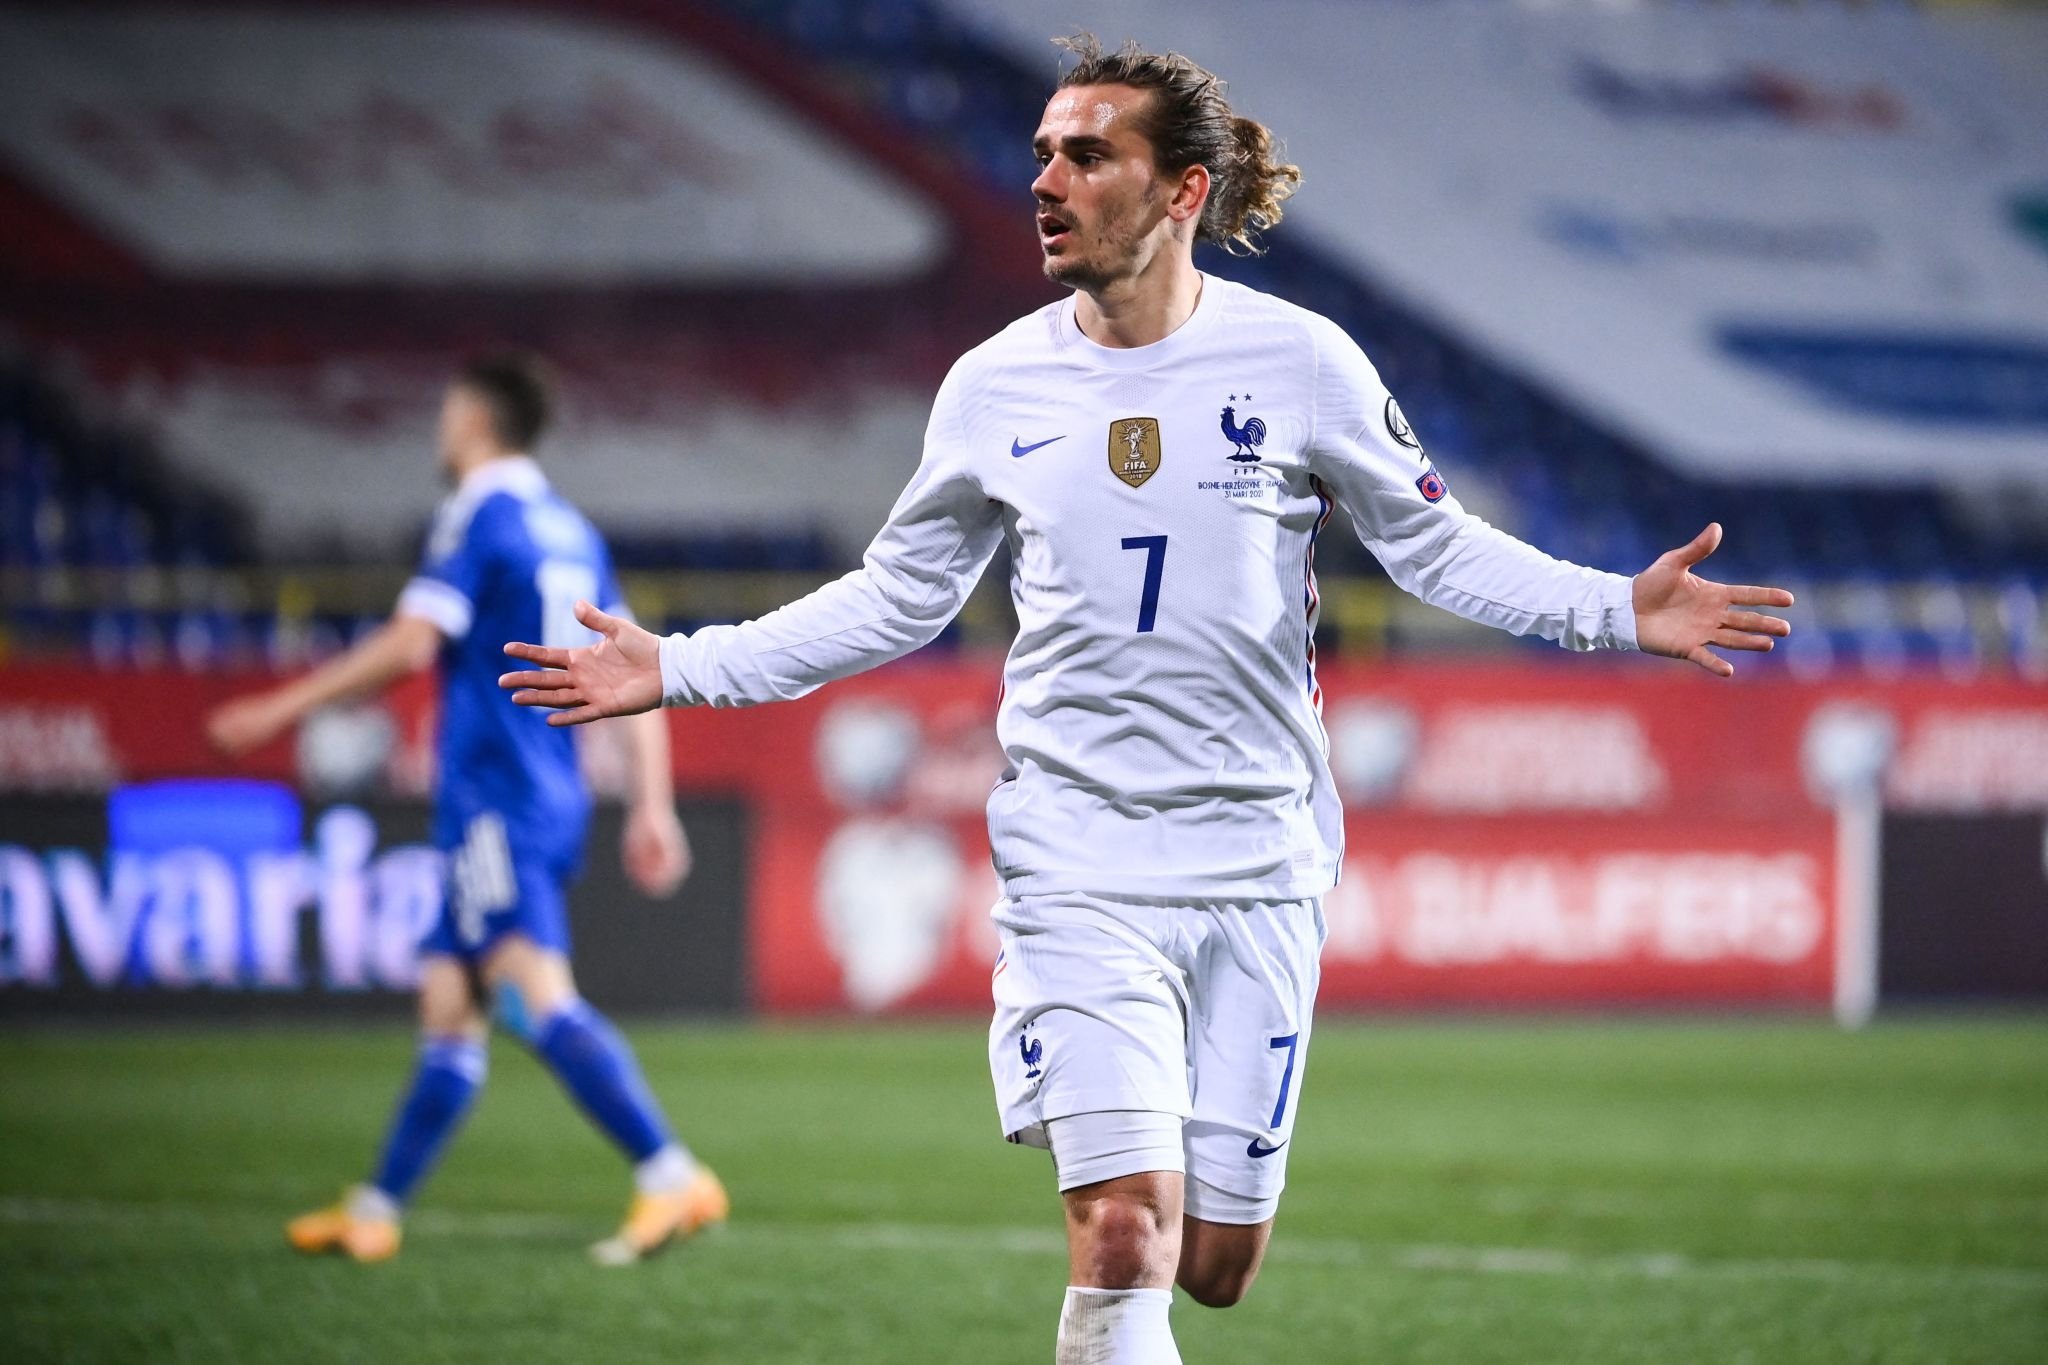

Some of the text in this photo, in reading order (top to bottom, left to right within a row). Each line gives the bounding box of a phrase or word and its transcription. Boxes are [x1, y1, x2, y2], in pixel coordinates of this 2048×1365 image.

[1124, 461, 1147, 470] FIFA
[1224, 490, 1264, 498] 31 MARS 2021
[1121, 535, 1168, 633] 7
[1270, 1031, 1303, 1129] 7
